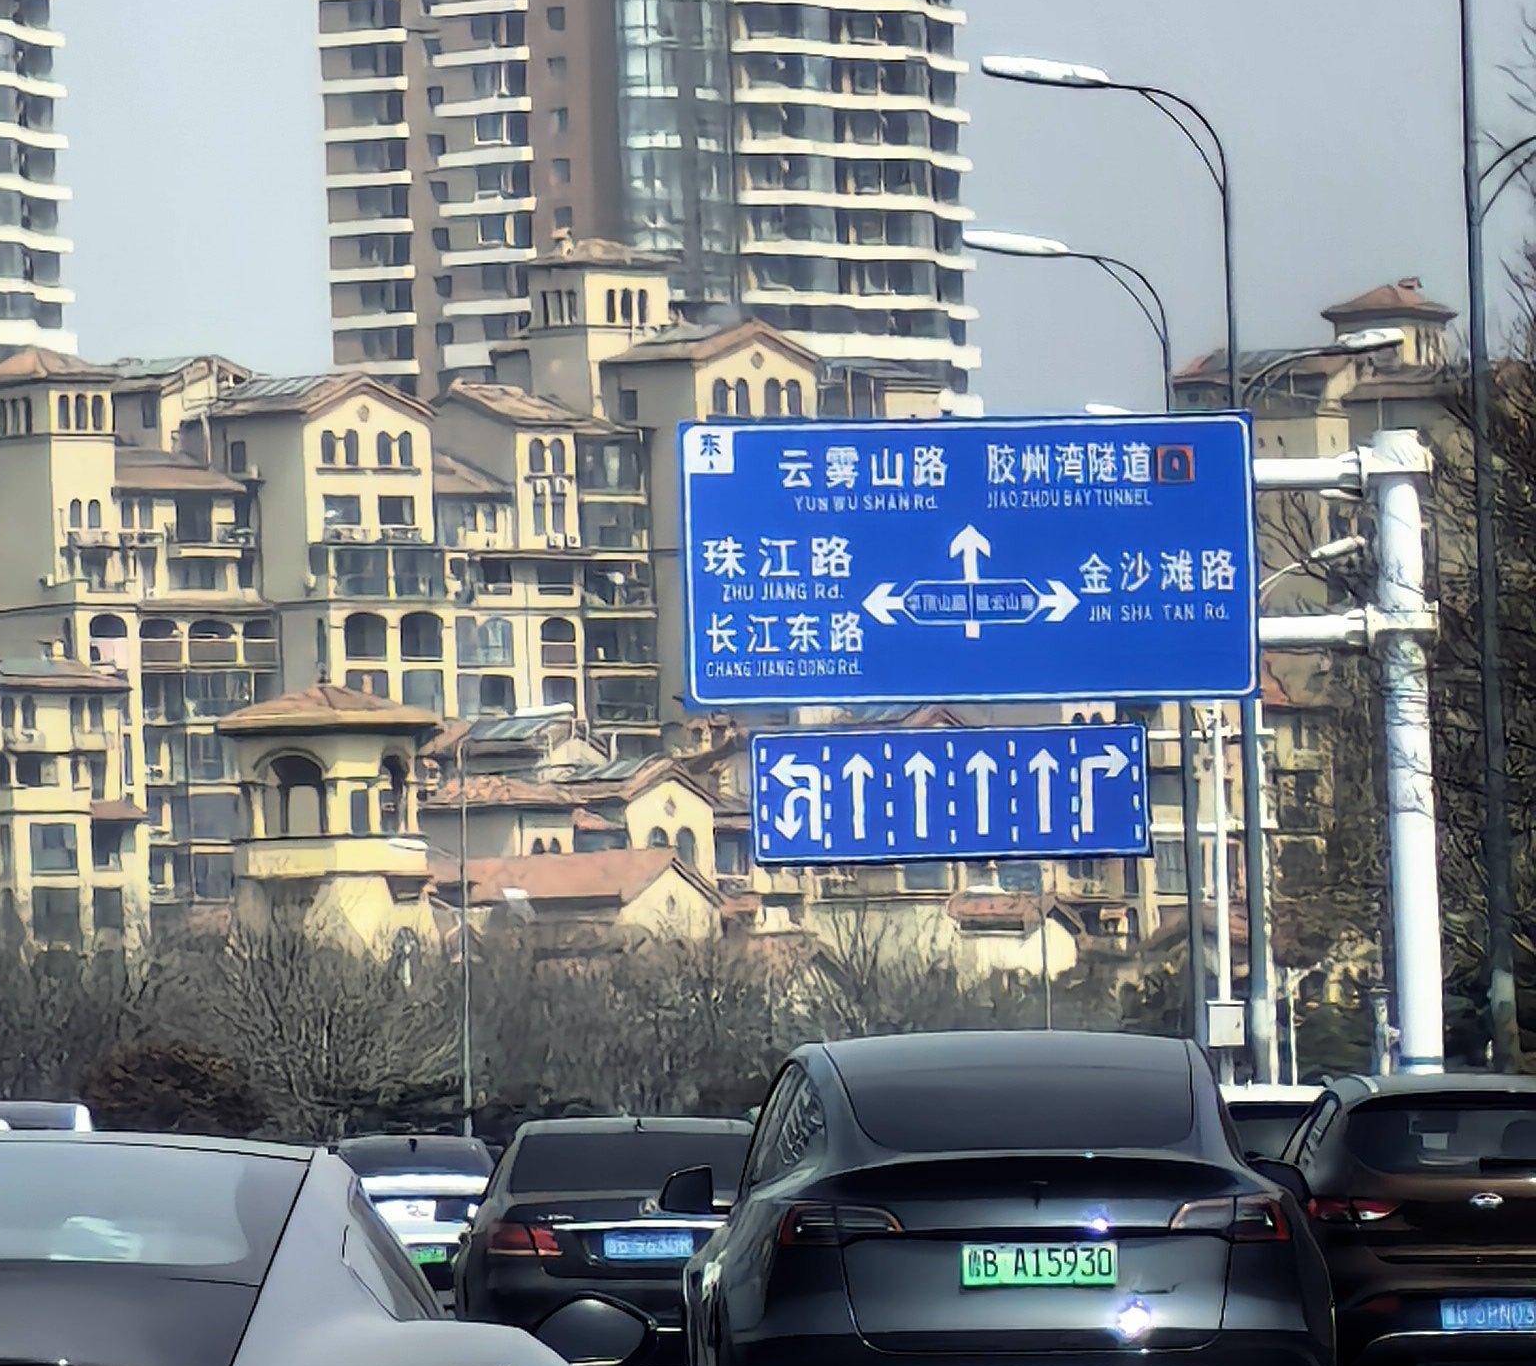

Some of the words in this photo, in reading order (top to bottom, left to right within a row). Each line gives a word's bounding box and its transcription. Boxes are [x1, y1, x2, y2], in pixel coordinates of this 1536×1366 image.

[700, 433, 721, 456] 东
[778, 445, 947, 488] 云雾山路
[986, 442, 1152, 484] 胶州湾隧道
[794, 495, 828, 512] YUN
[863, 494, 910, 511] SHAN
[987, 490, 1018, 508] JIAO
[1021, 489, 1060, 507] ZHOU
[1093, 488, 1153, 506] TUNNEL
[702, 536, 853, 579] 珠江路
[1079, 548, 1236, 594] 金沙滩路
[722, 583, 754, 602] ZHU
[761, 582, 807, 601] JIANG
[815, 583, 845, 600] Rd.
[1089, 604, 1112, 622] JIN
[1121, 603, 1153, 622] SHA
[1163, 604, 1195, 621] TAN
[706, 611, 864, 653] 长江东路
[706, 661, 752, 677] CHANG
[756, 660, 796, 677] JIANG
